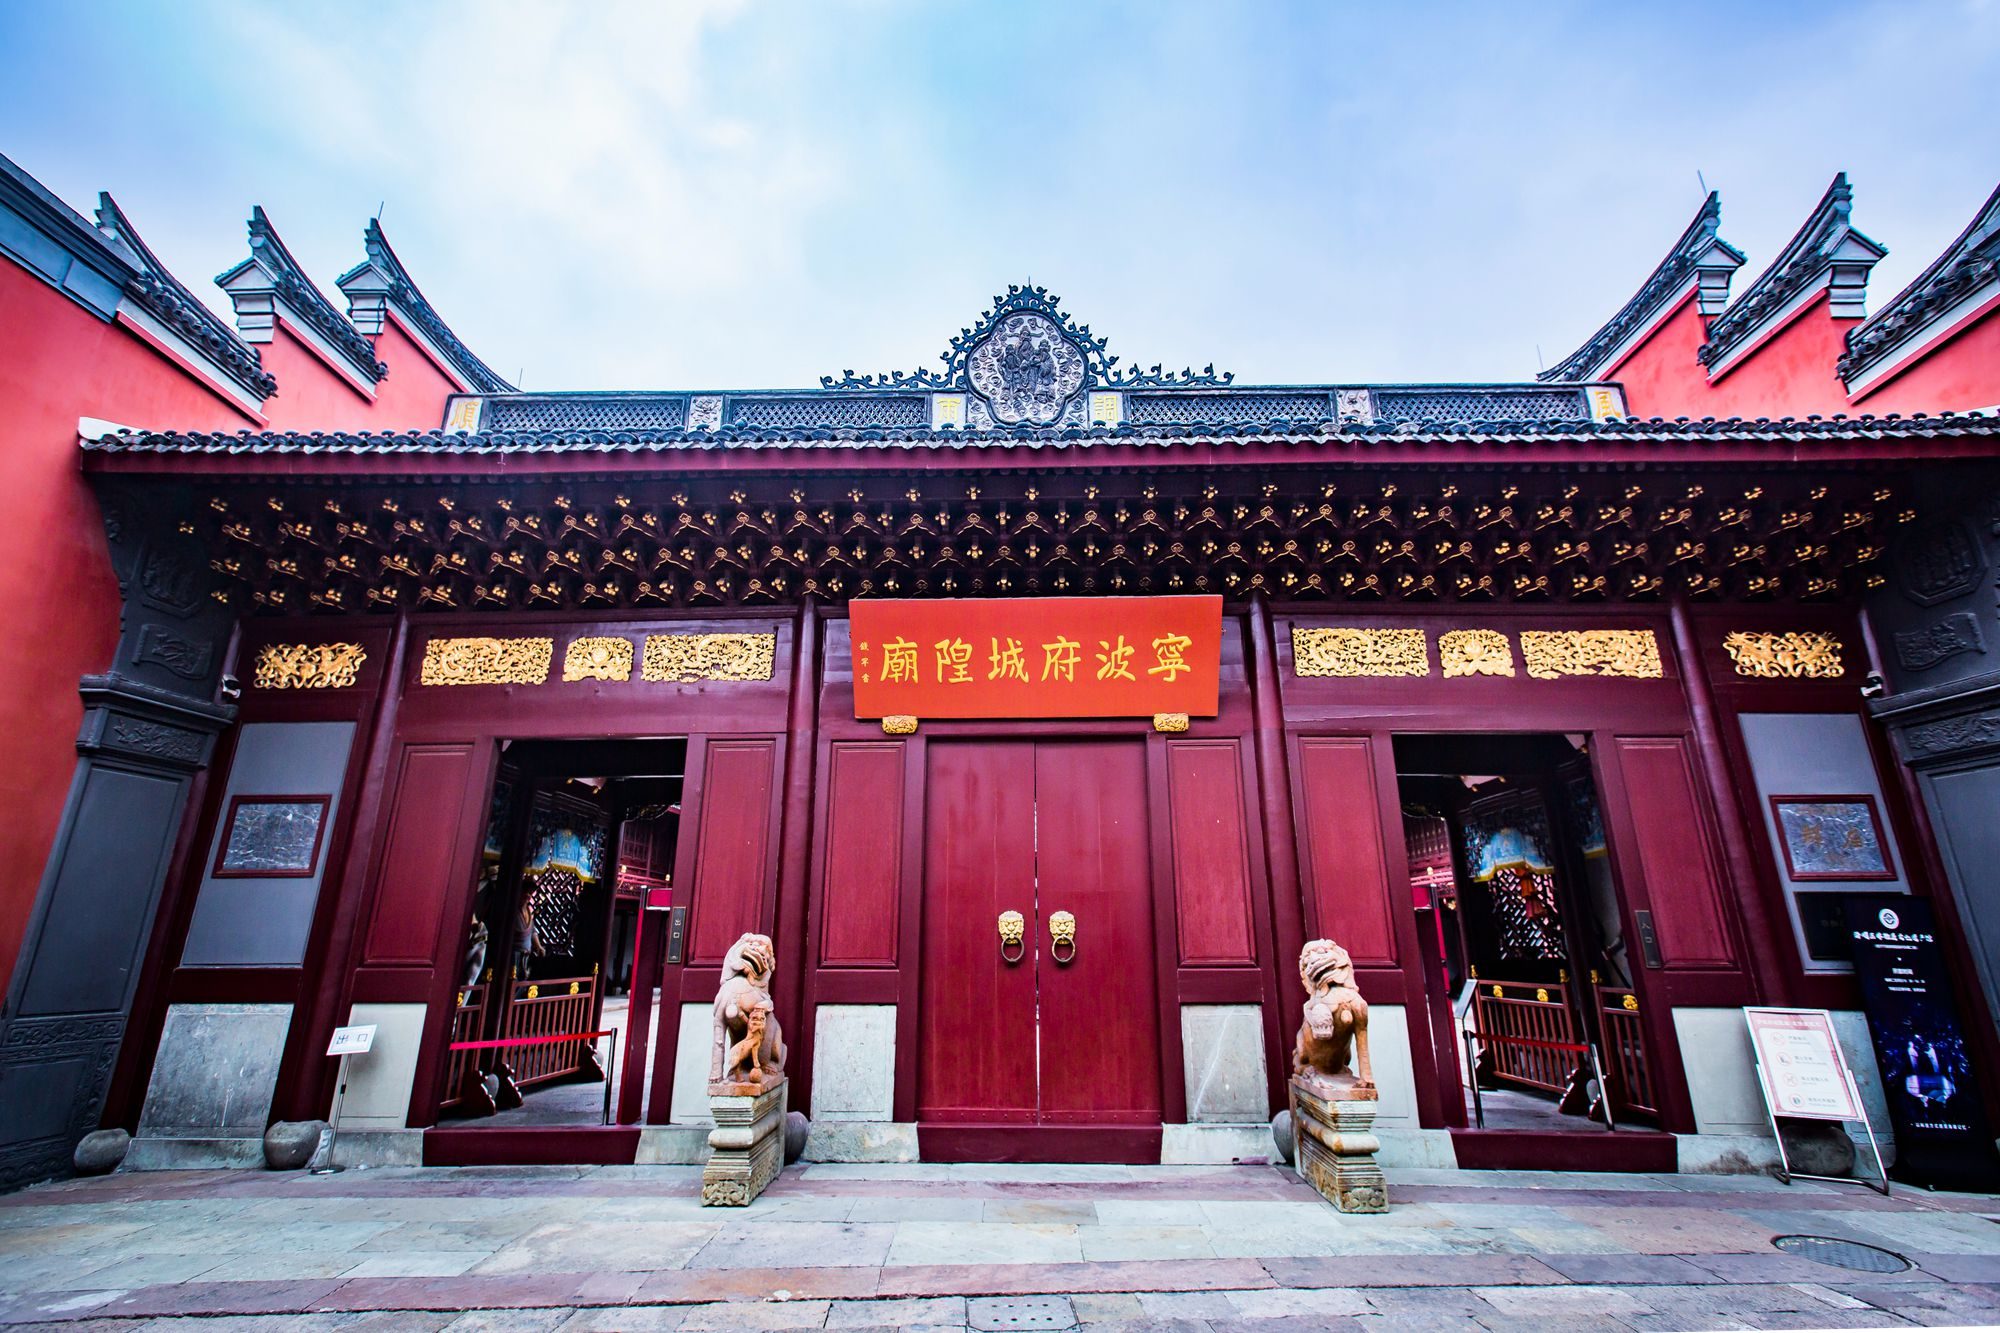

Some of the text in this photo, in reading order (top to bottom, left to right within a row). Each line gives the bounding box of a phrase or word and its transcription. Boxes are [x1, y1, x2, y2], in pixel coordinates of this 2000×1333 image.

[450, 391, 1621, 430] 風 調 雨 順
[336, 1033, 369, 1045] 出口
